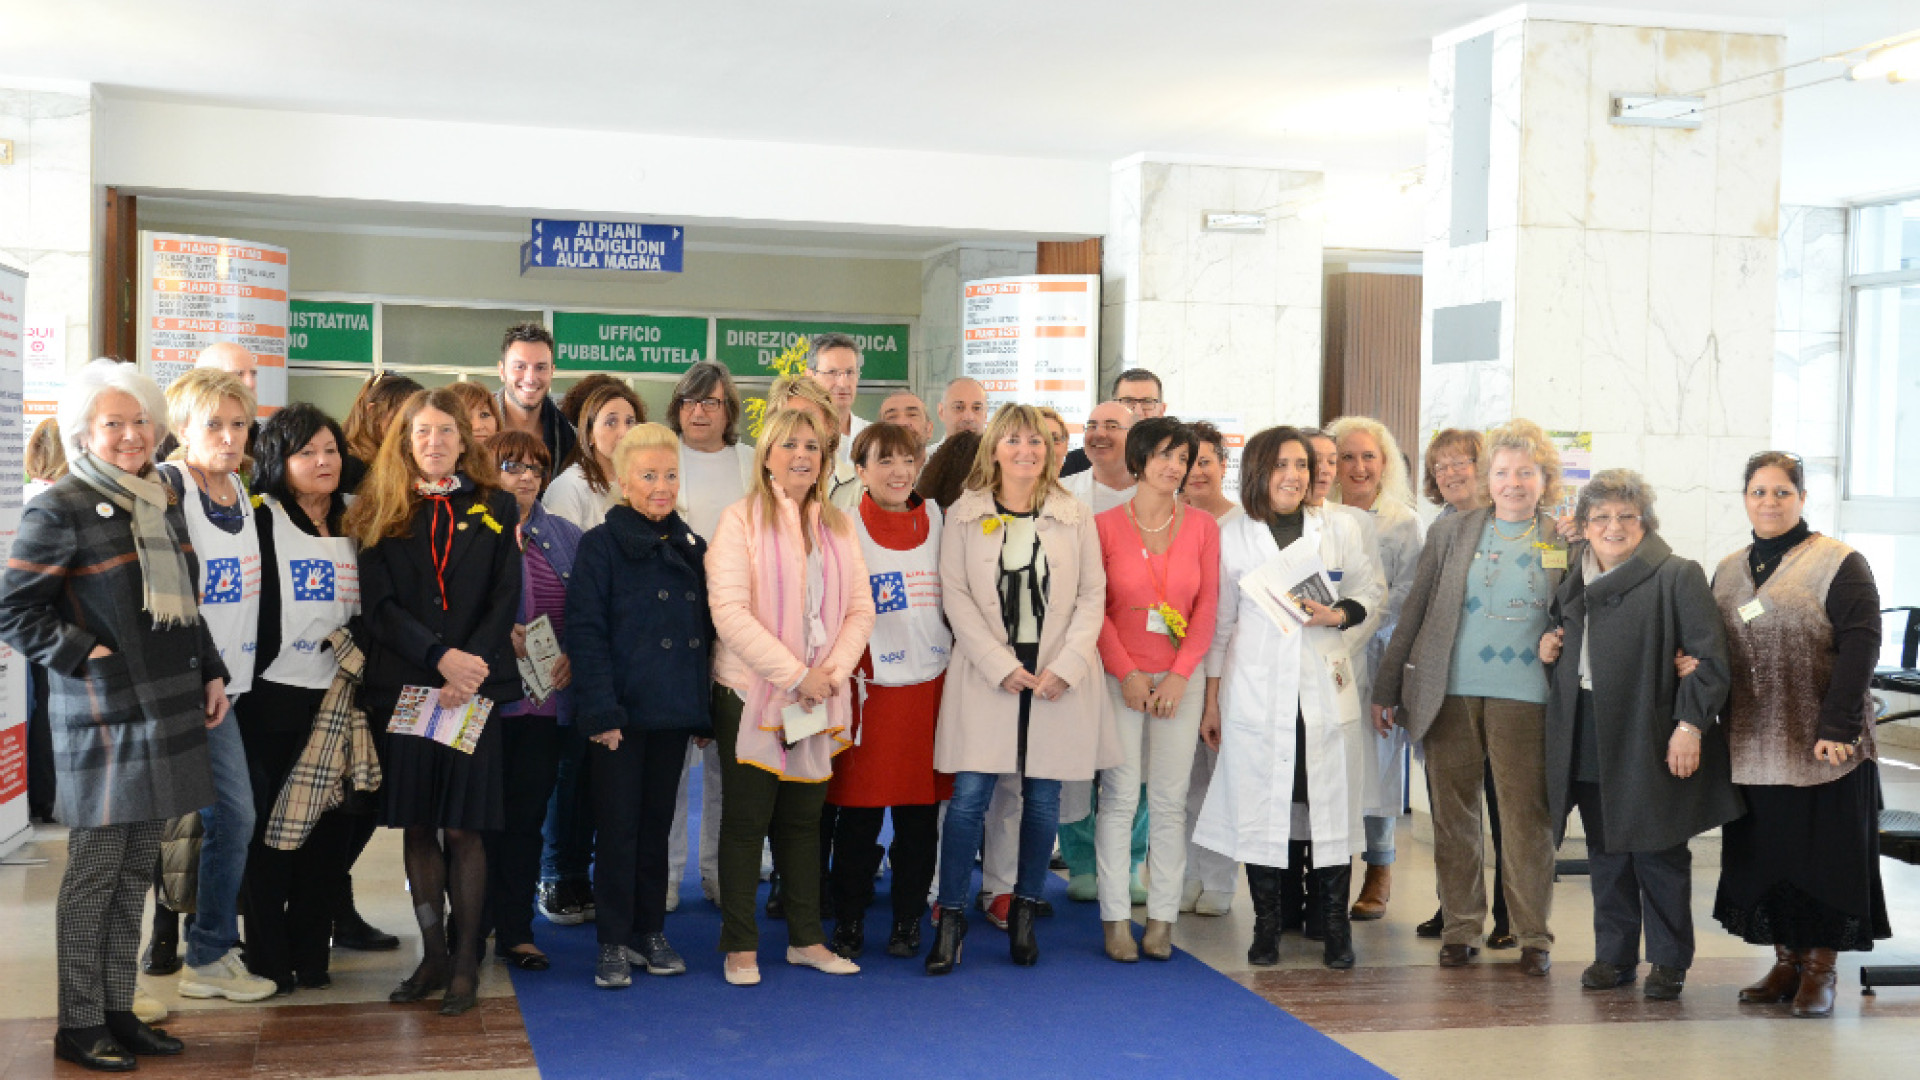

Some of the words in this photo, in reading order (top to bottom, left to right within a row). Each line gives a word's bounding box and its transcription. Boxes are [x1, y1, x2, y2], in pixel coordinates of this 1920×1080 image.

[576, 222, 594, 237] AI
[599, 223, 642, 239] PIANI
[180, 242, 218, 254] PIANO
[552, 236, 569, 251] AI
[574, 238, 665, 255] PADIGLIONI
[556, 252, 599, 267] AULA
[604, 254, 661, 270] MAGNA
[178, 281, 216, 294] PIANO
[178, 320, 216, 331] PIANO
[599, 324, 661, 342] UFFICIO
[557, 343, 636, 362] PUBBLICA
[641, 347, 700, 363] TUTELA
